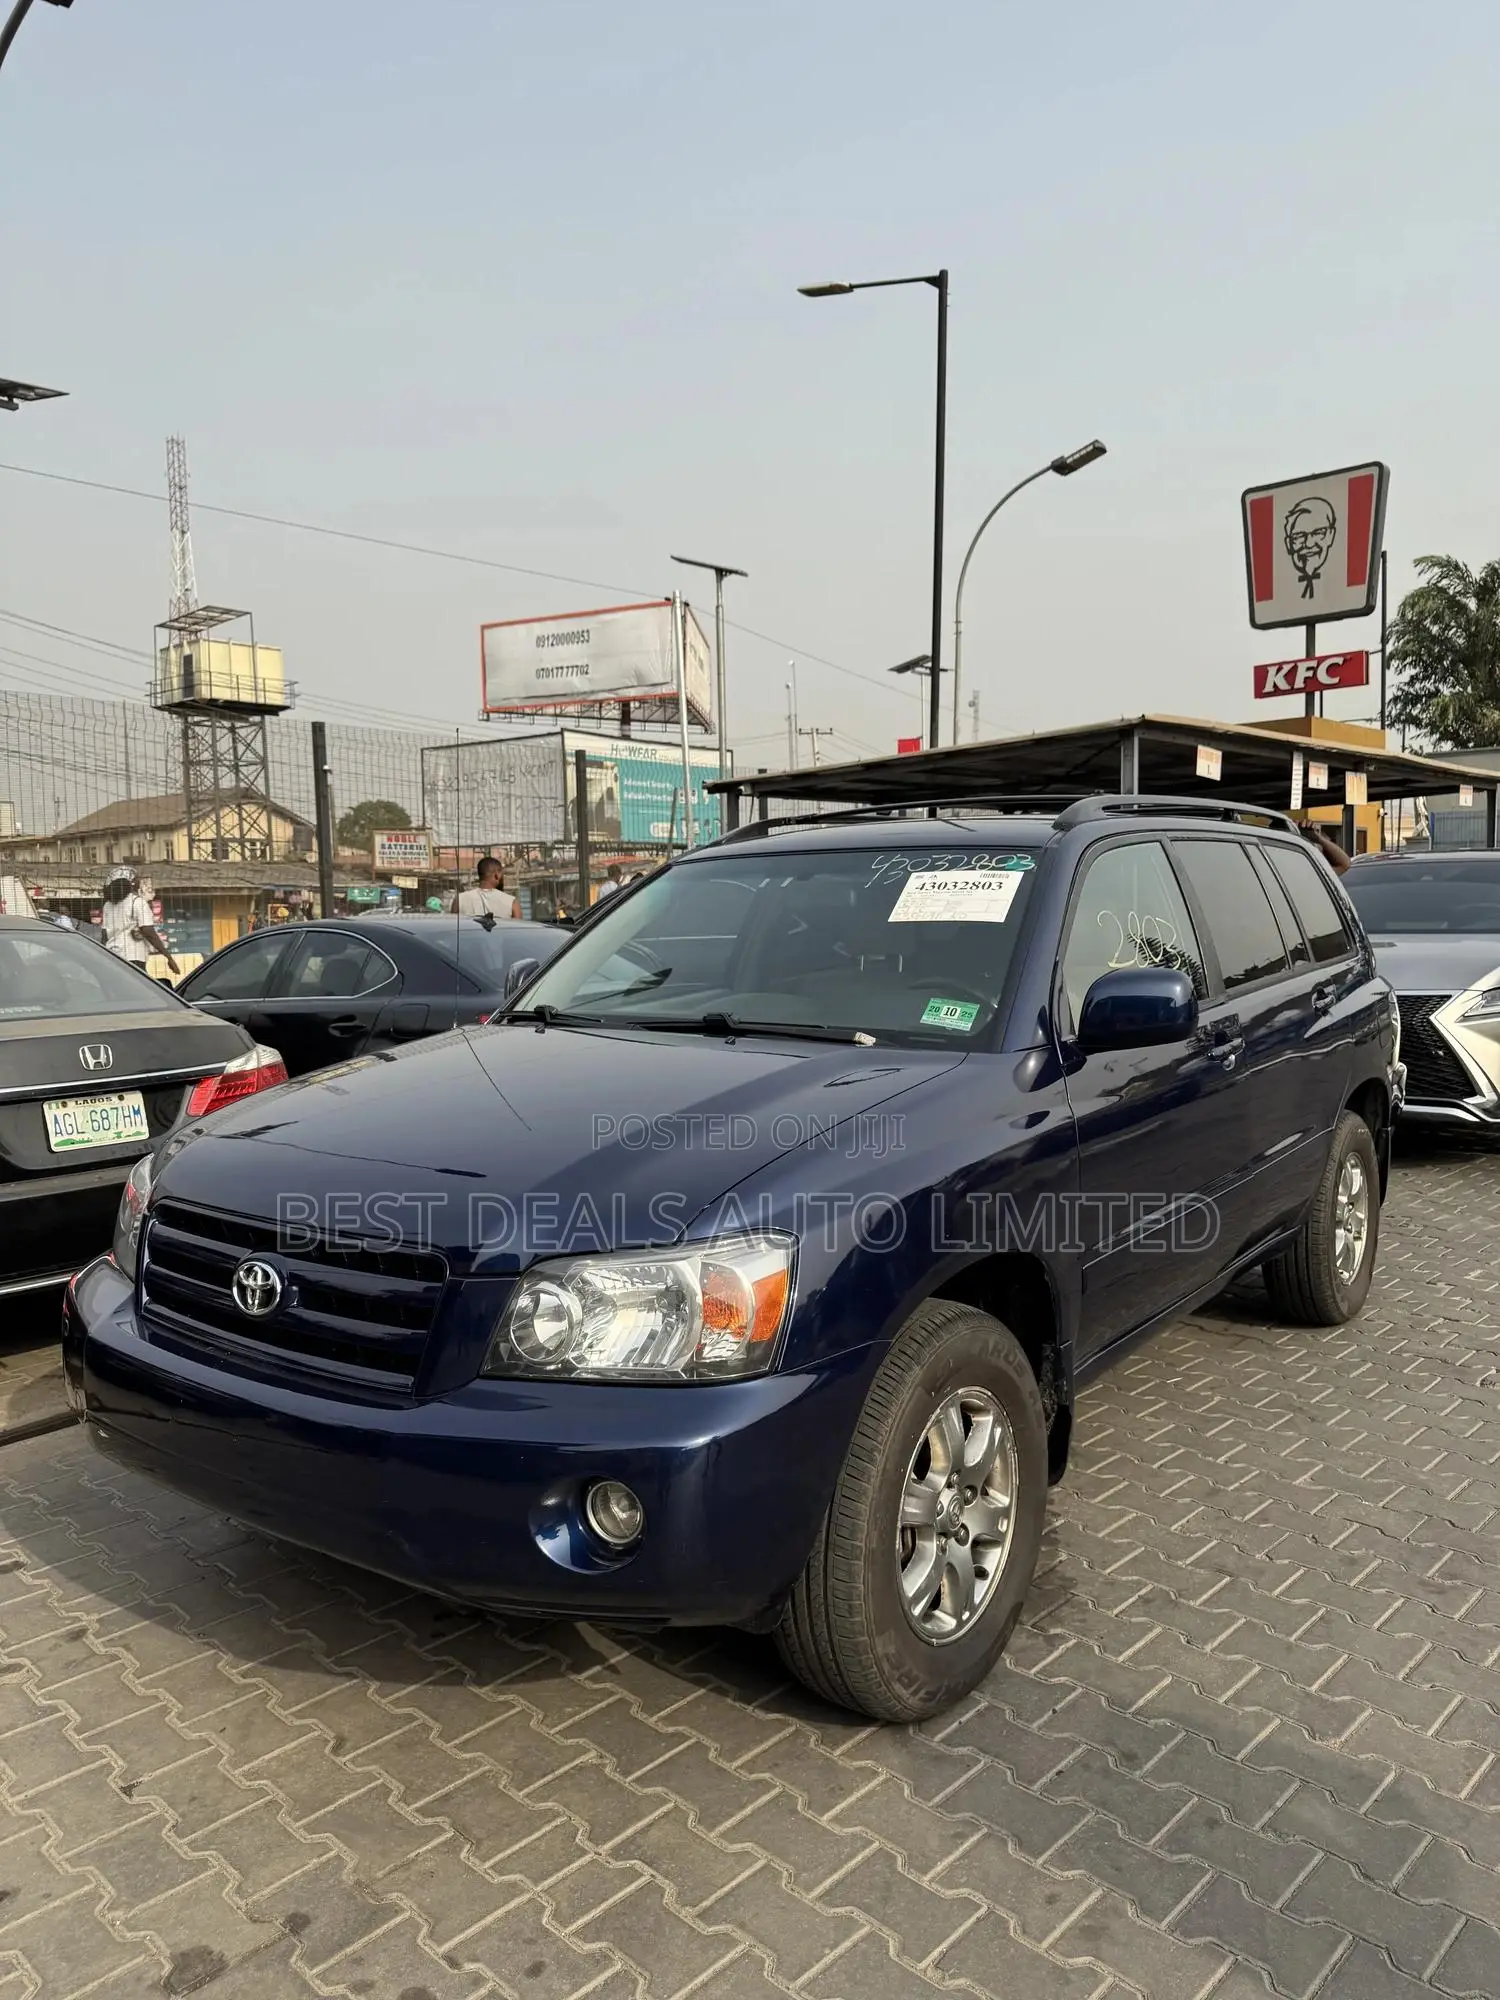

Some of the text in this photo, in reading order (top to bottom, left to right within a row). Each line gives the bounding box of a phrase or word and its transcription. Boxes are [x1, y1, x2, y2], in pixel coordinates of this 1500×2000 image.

[536, 629, 590, 648] 09120000953
[536, 664, 589, 680] 07017777702
[1262, 656, 1344, 693] KFC
[915, 881, 1003, 891] 43032803
[1097, 910, 1181, 969] 2803
[928, 1005, 973, 1019] 20 10 25
[75, 1096, 113, 1106] LAGOS
